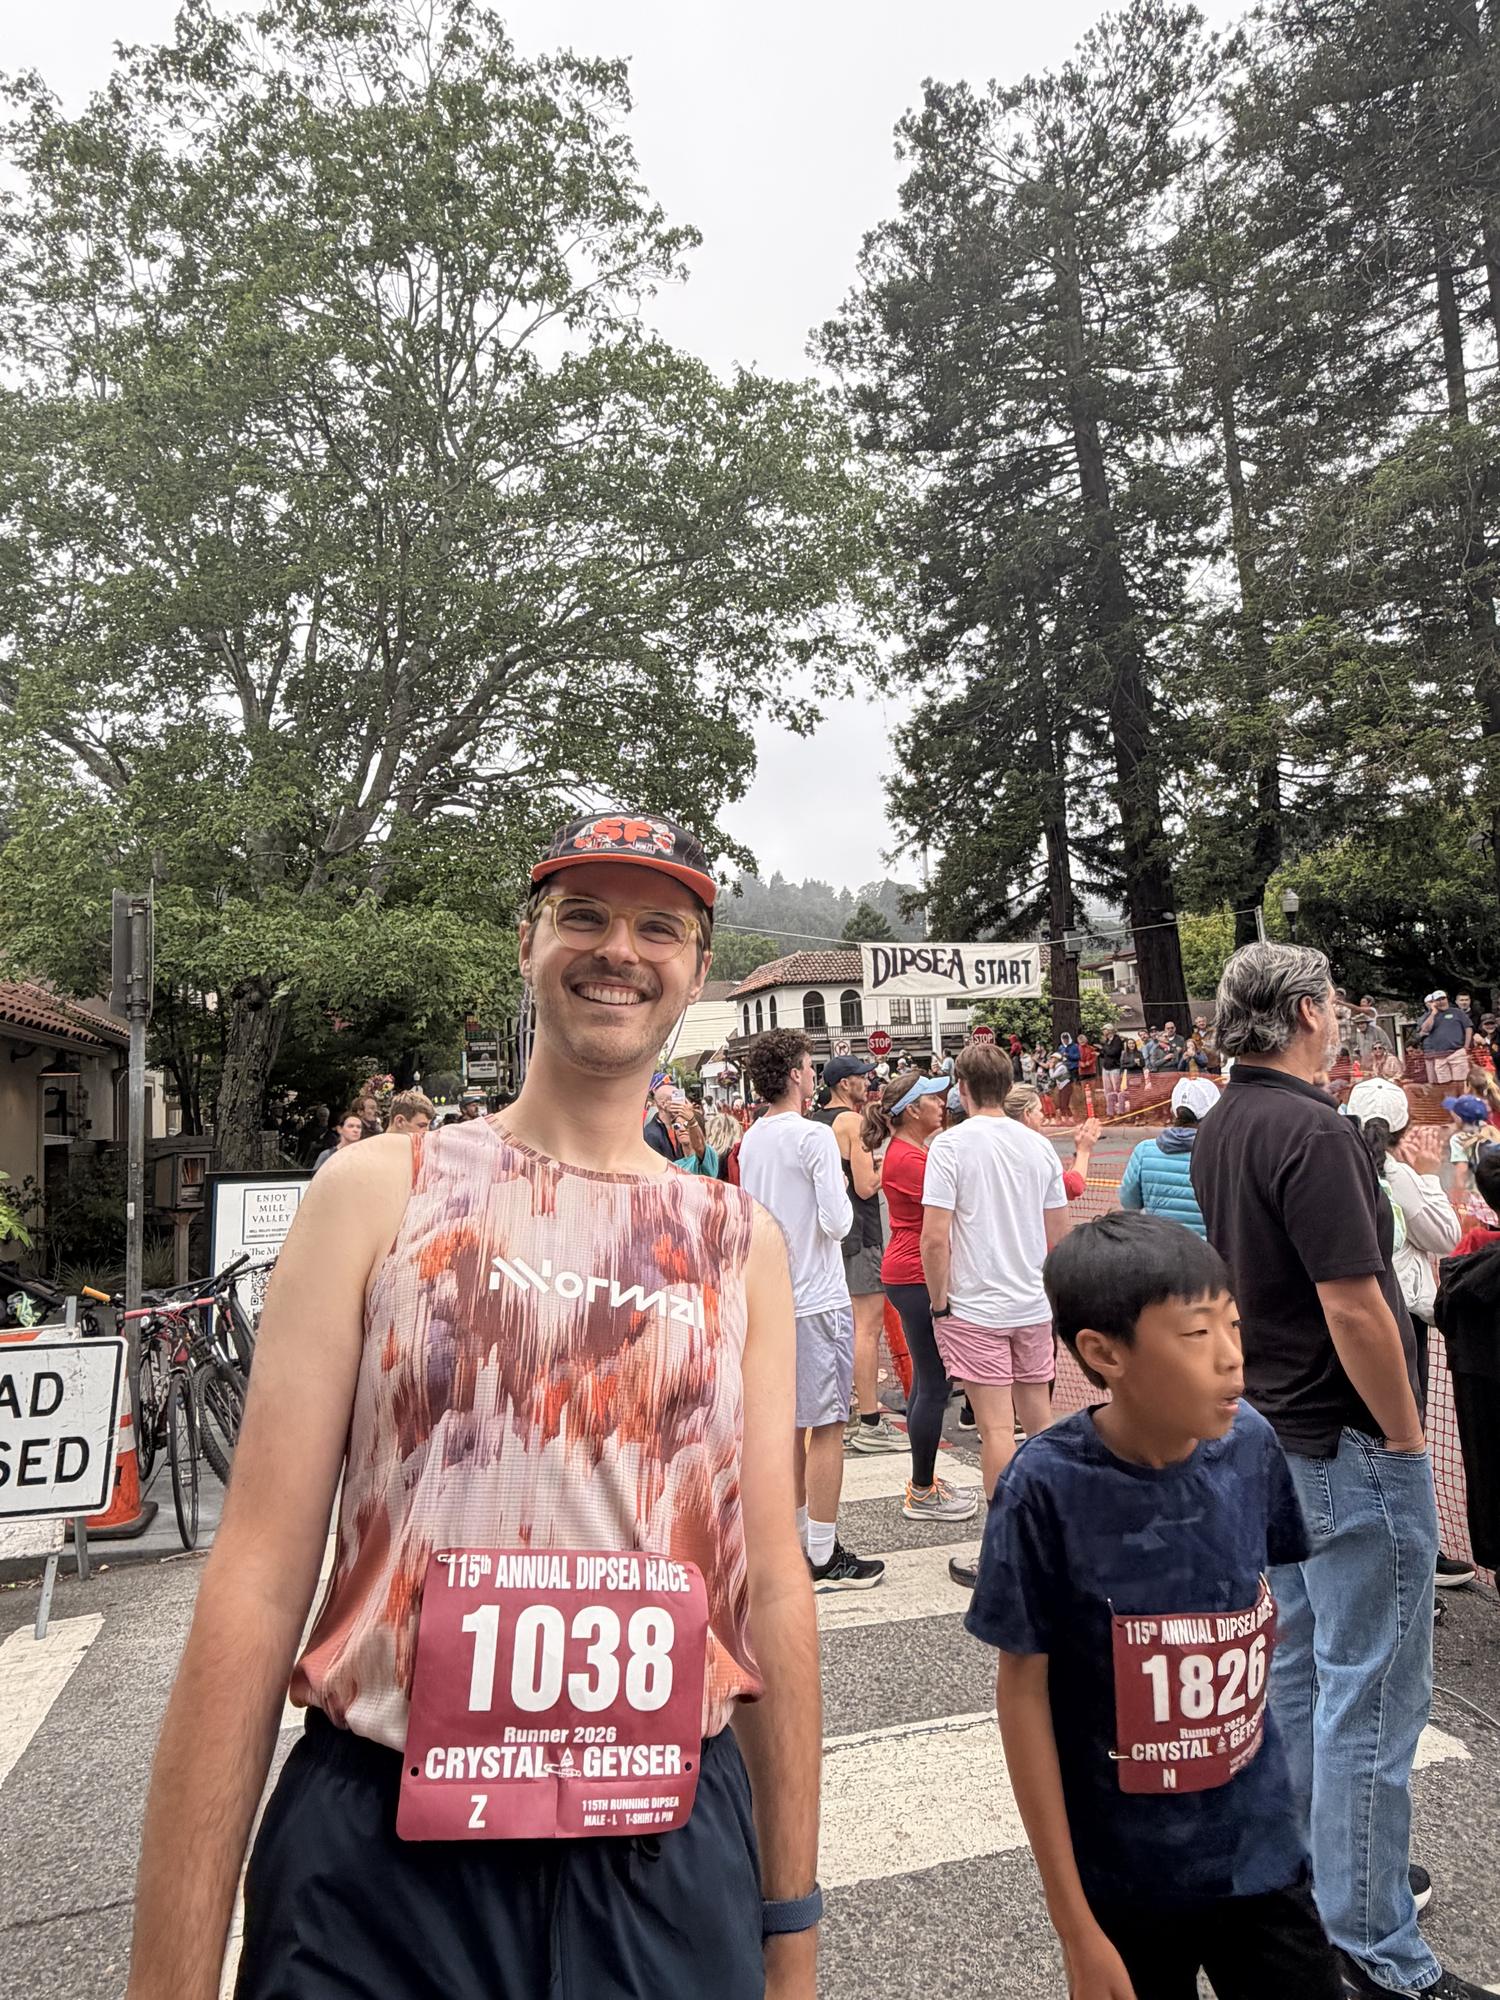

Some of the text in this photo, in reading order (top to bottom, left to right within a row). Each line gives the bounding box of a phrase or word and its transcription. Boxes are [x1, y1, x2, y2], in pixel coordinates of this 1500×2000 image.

[594, 819, 652, 842] SF
[871, 947, 1031, 989] DIPSEA START
[869, 1037, 891, 1049] STOP
[974, 1033, 993, 1044] STOP
[256, 1193, 288, 1202] ENJOY
[259, 1204, 285, 1212] MILL
[252, 1214, 291, 1223] VALLEY
[249, 1247, 265, 1256] The
[447, 1554, 690, 1592] 115th ANNUAL DIPSEA RACE
[1161, 1618, 1216, 1646] ANNUAL
[1216, 1611, 1256, 1642] DIPSEA
[462, 1605, 675, 1712] 1038
[1142, 1634, 1266, 1722] 1826
[504, 1726, 617, 1743] Runner 2026
[1179, 1726, 1222, 1740] Runner
[1131, 1739, 1213, 1761] CRYSTAL
[425, 1745, 681, 1779] CRYSTAL GEYSER
[1163, 1769, 1176, 1789] N
[468, 1795, 488, 1828] Z
[582, 1796, 680, 1811] 115TH RUNNING DIPSEA
[584, 1814, 606, 1826] MALE
[612, 1814, 617, 1825] L
[625, 1812, 653, 1824] T-SHIRT
